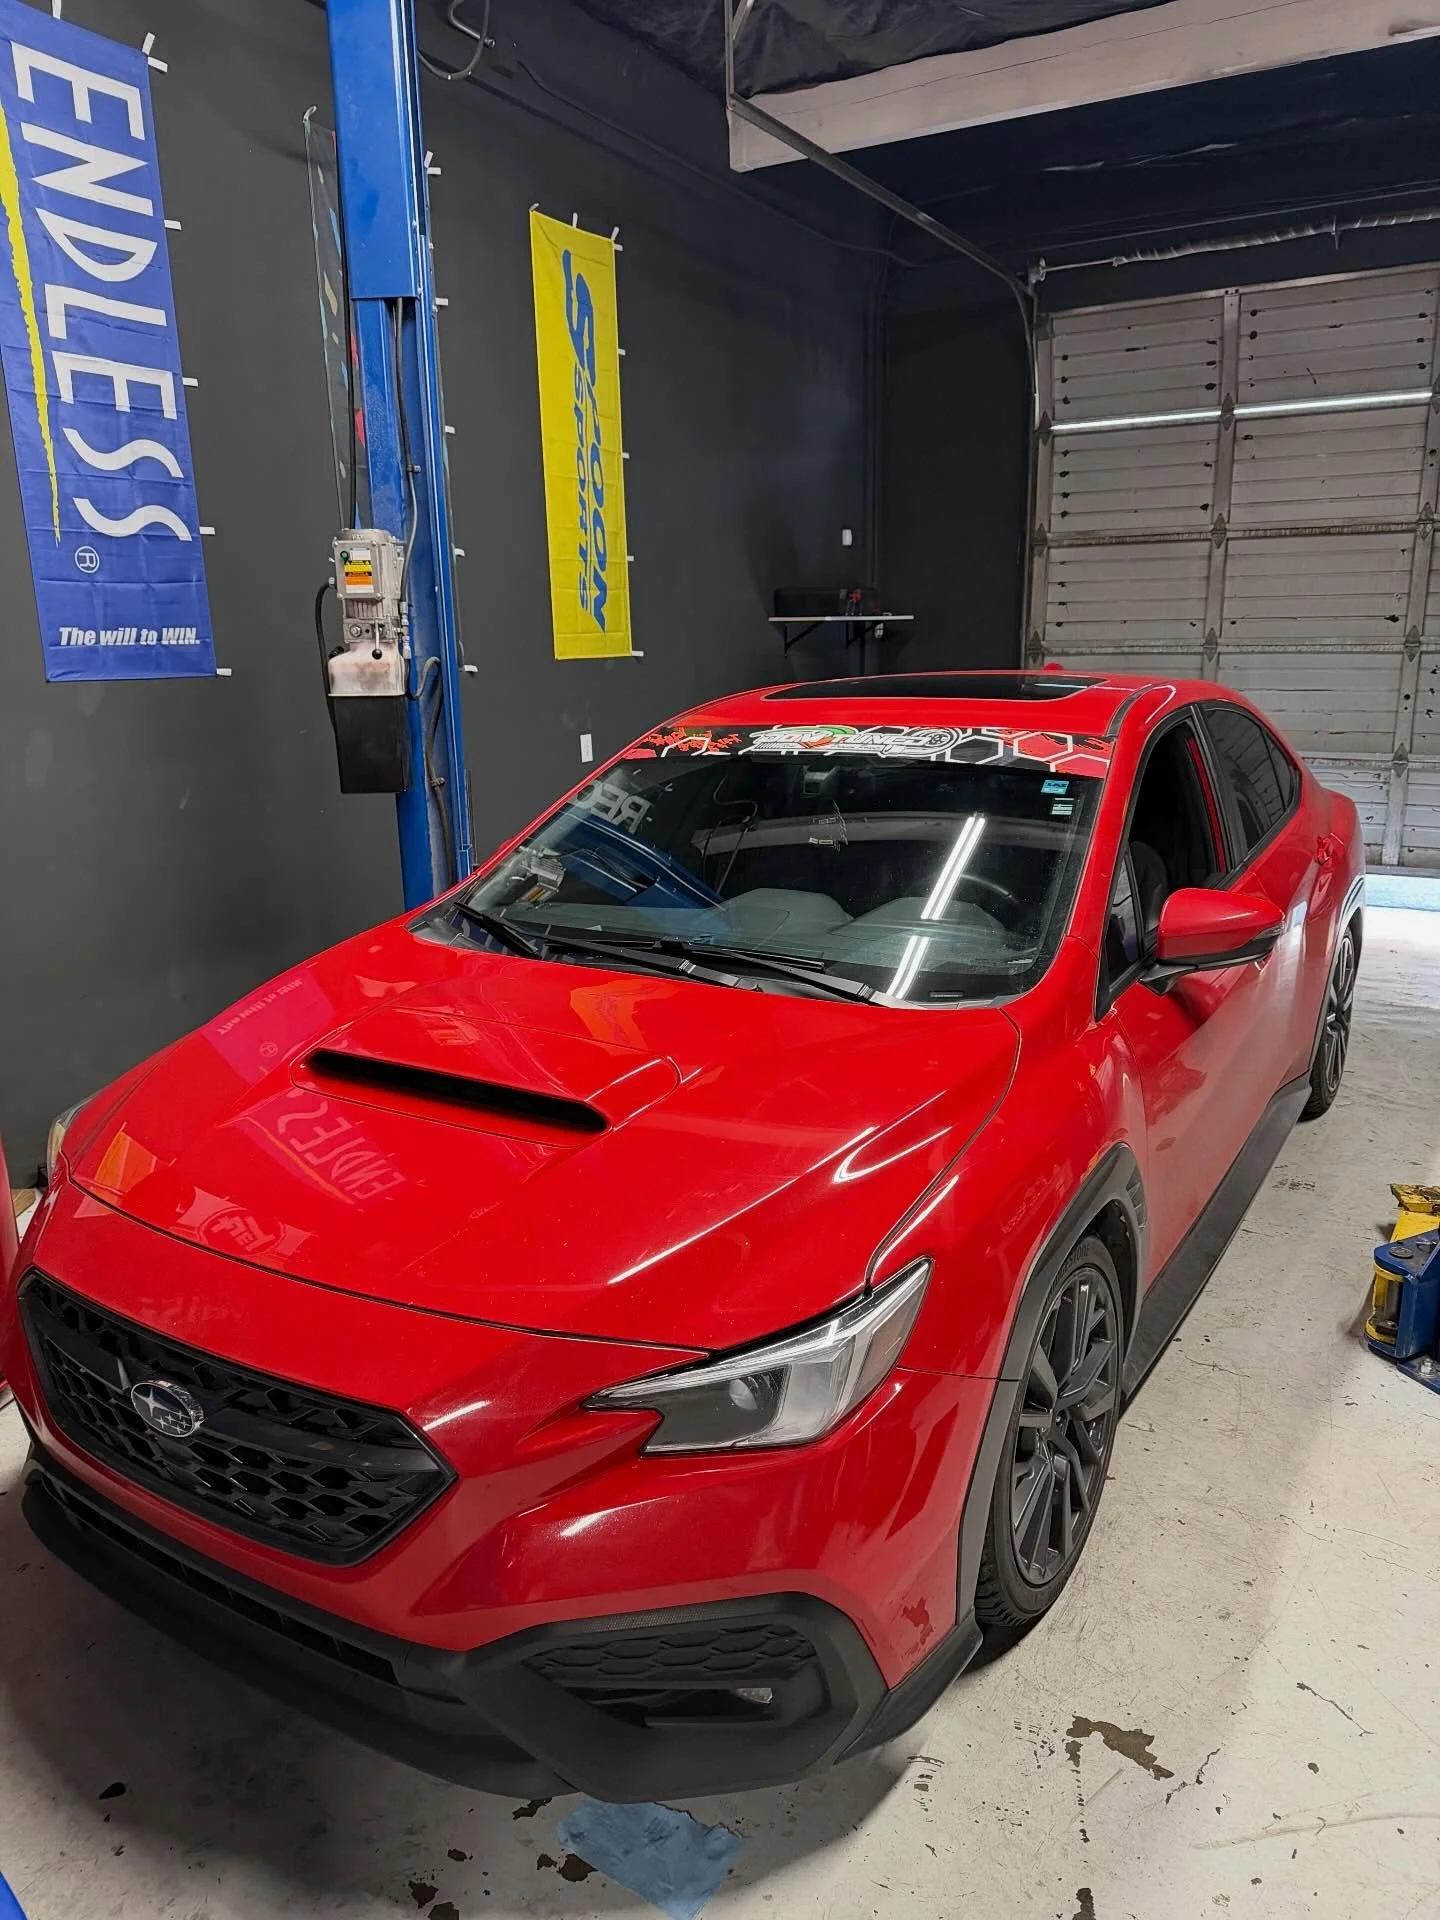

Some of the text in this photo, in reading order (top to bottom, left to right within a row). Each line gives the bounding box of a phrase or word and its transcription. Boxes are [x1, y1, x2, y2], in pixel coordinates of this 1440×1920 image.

[11, 40, 192, 542] ENDLESS
[562, 248, 609, 633] SPOON
[59, 627, 201, 646] The will to WIN.
[573, 366, 591, 613] SPORTS
